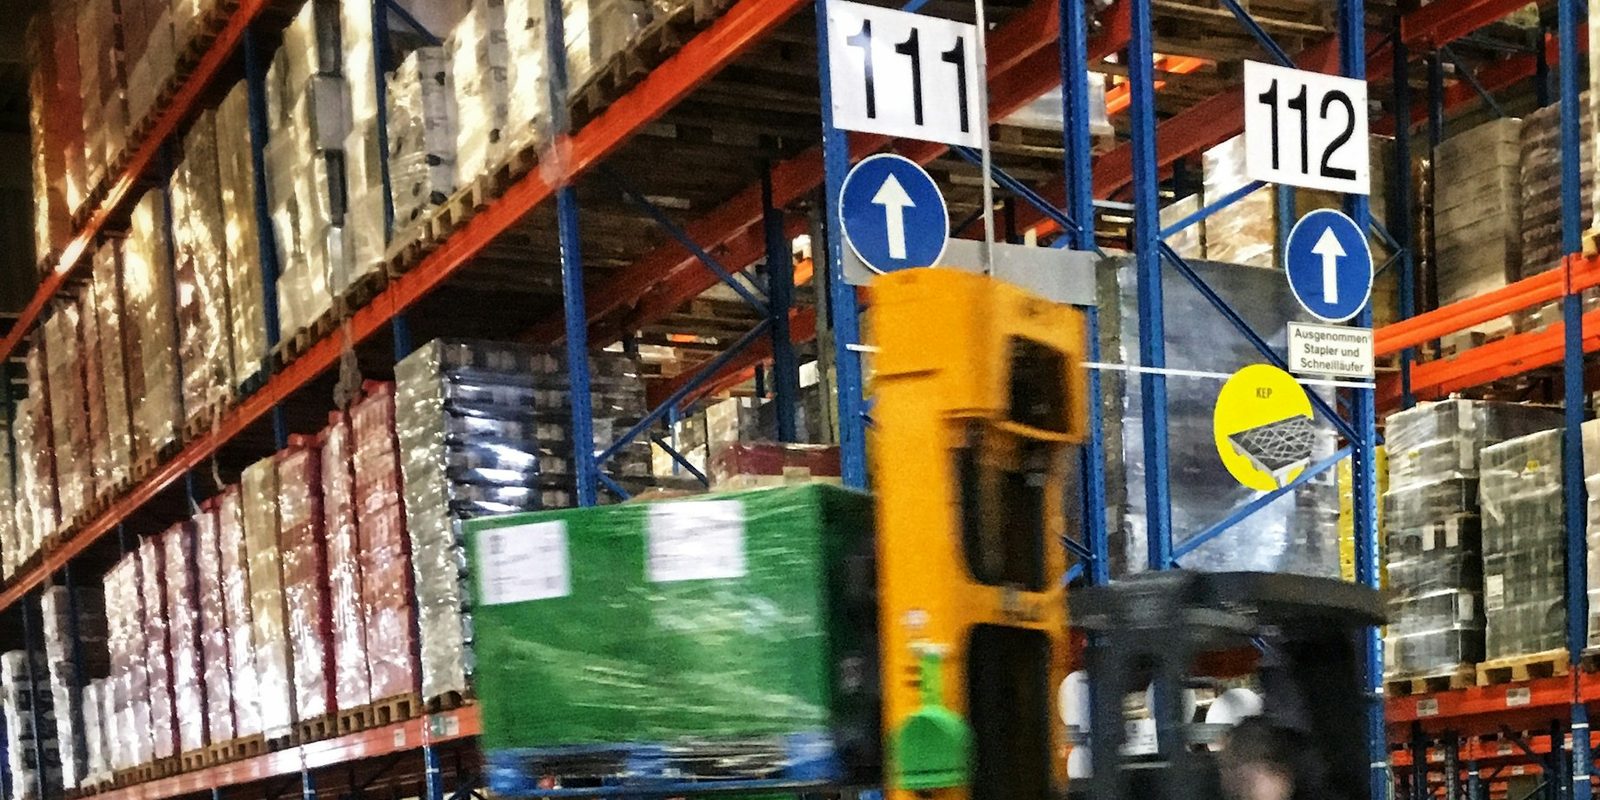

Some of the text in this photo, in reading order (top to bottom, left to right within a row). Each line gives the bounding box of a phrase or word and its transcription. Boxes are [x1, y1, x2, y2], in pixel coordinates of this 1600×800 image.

[847, 19, 969, 133] 111
[1259, 79, 1356, 181] 112
[1295, 328, 1368, 344] Ausgenommen
[1304, 343, 1360, 357] Stapler und
[1256, 387, 1273, 399] KEP
